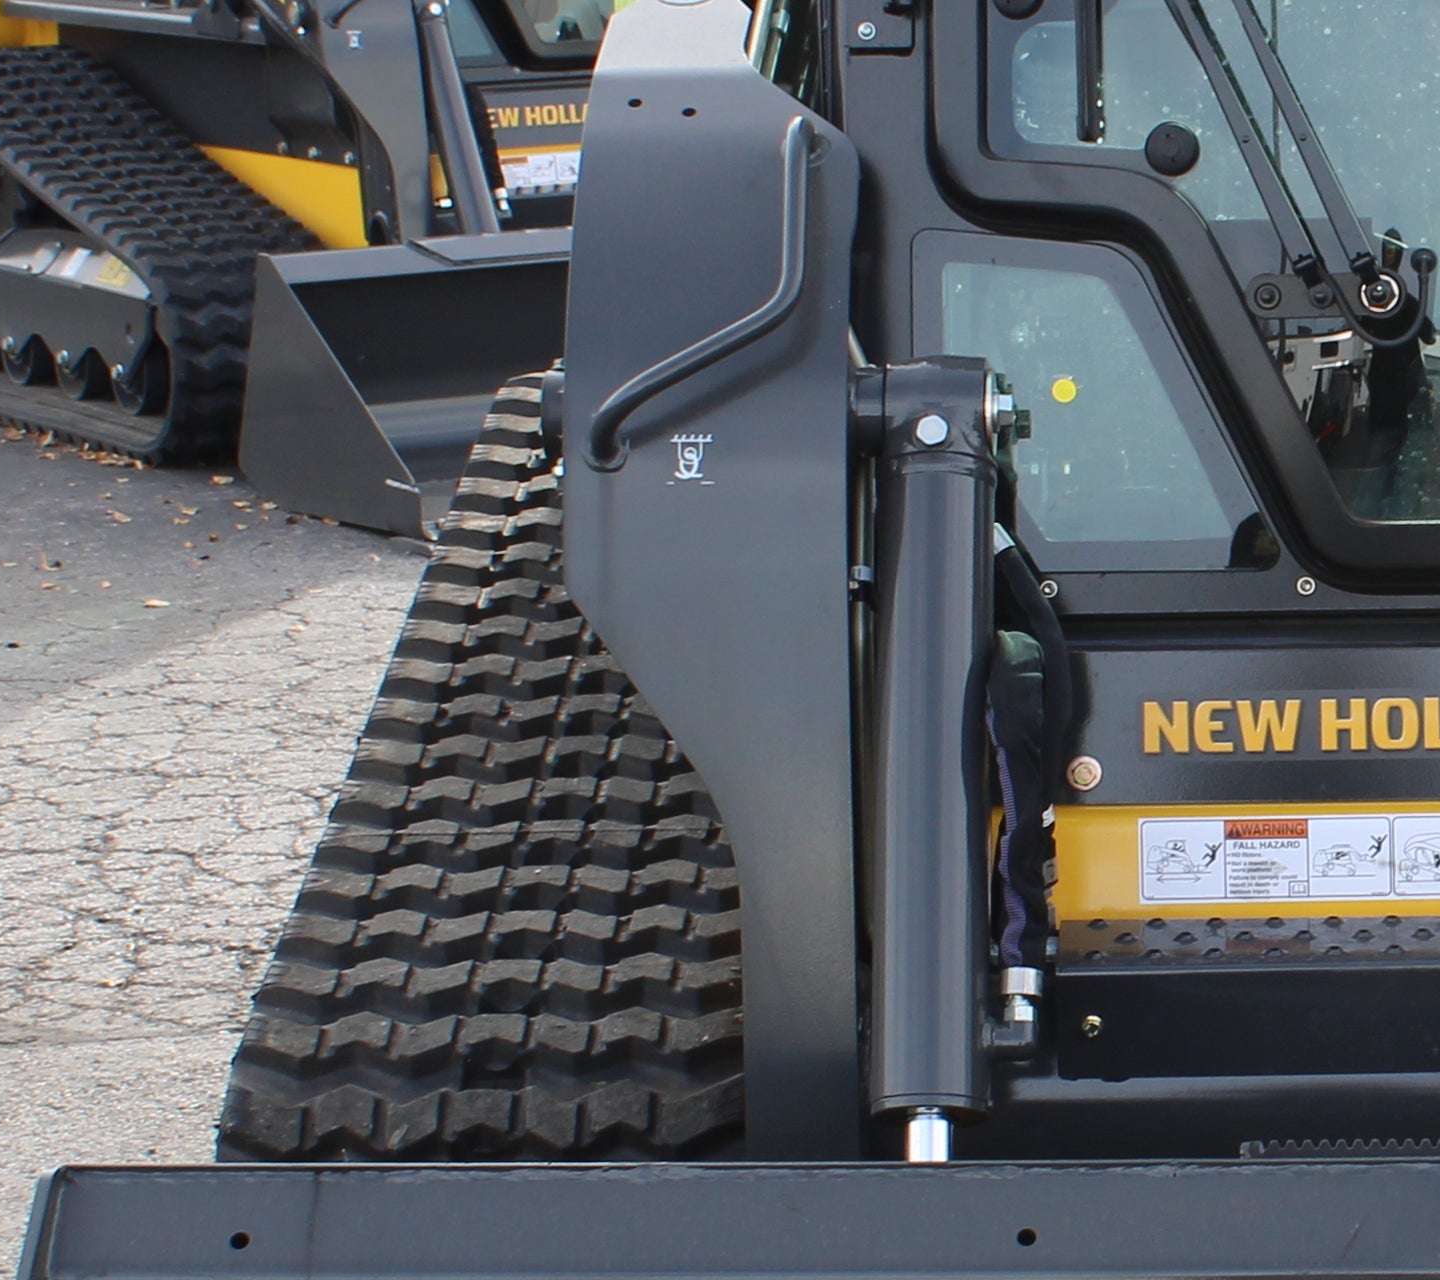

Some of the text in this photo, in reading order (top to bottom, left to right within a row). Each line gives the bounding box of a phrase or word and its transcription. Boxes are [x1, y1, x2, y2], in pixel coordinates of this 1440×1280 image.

[486, 102, 589, 129] EW HOLL
[1142, 699, 1302, 755] NEW
[1241, 823, 1305, 835] WARNING
[1233, 840, 1301, 849] FALL HAZARD
